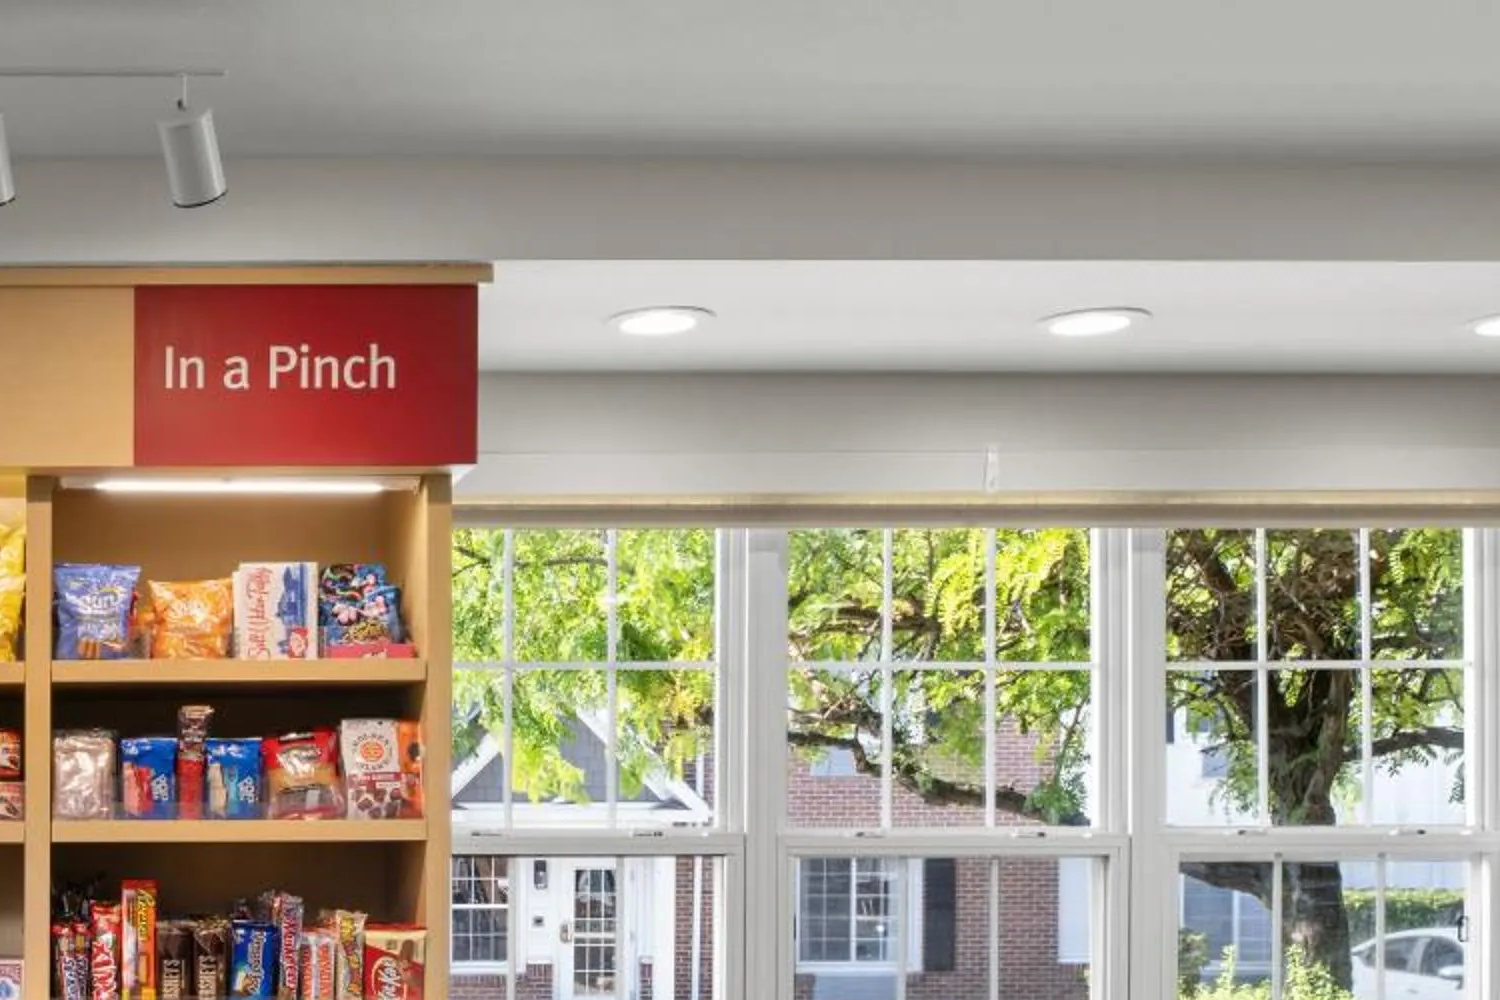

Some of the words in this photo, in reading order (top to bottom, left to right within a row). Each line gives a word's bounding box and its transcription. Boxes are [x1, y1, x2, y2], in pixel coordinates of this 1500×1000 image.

[164, 345, 206, 390] In
[222, 354, 251, 390] a
[268, 342, 397, 390] Pinch
